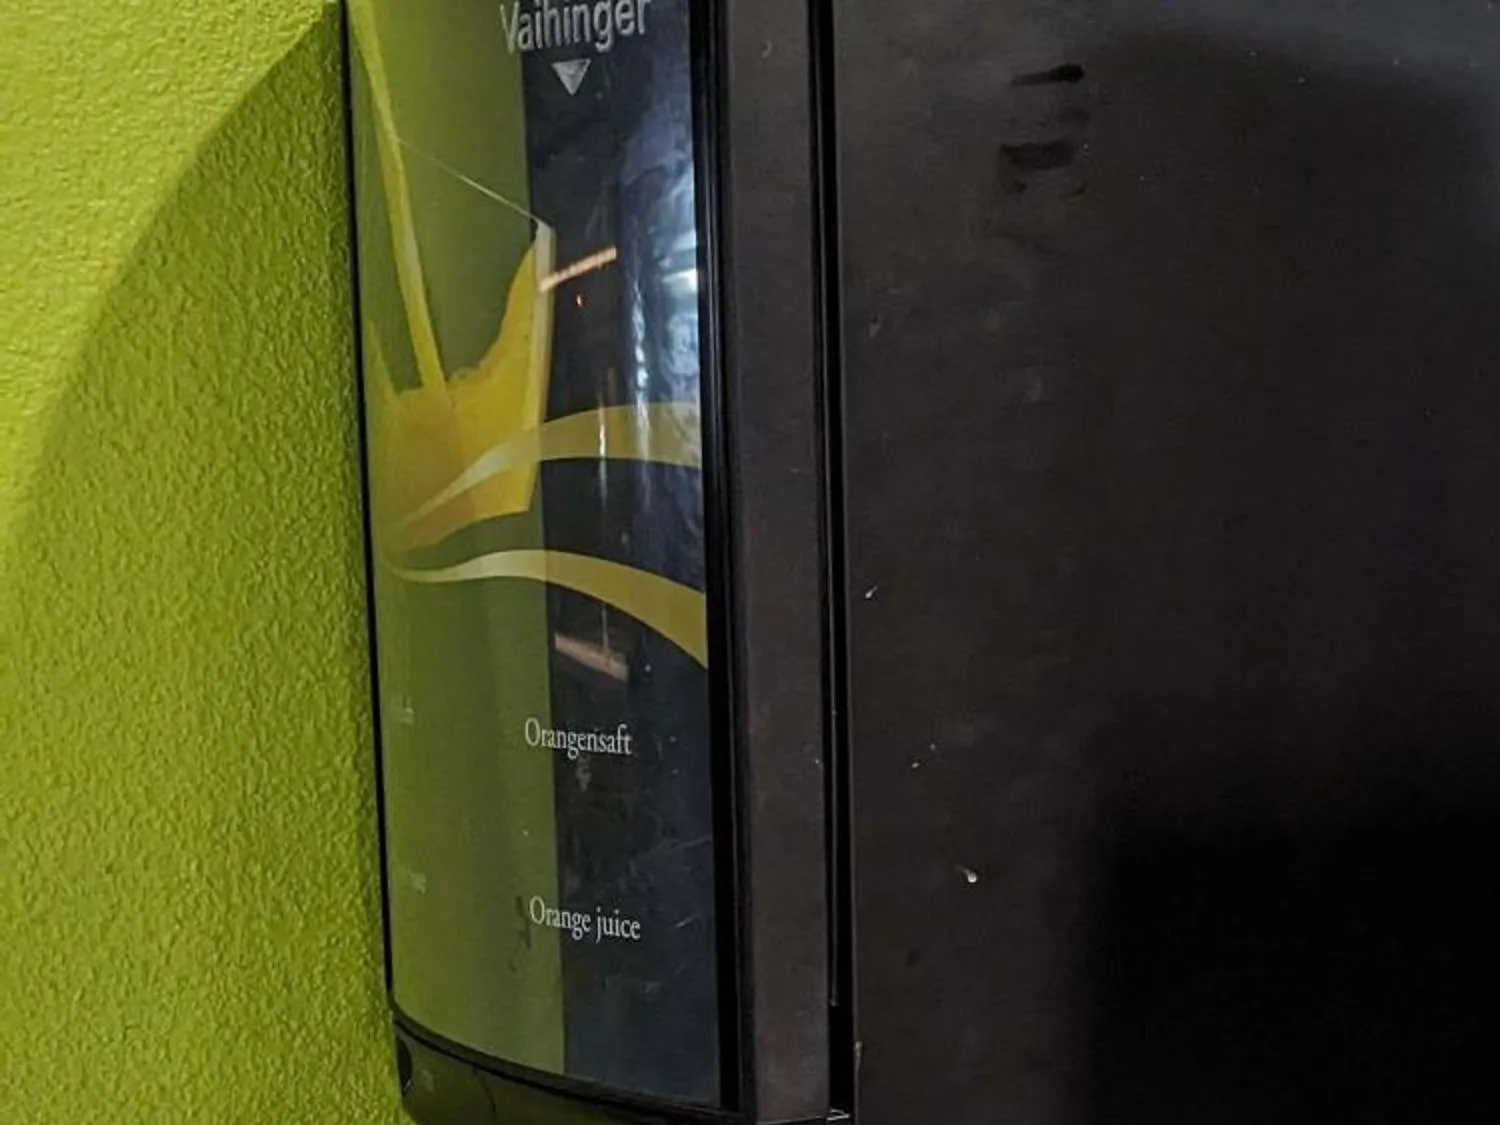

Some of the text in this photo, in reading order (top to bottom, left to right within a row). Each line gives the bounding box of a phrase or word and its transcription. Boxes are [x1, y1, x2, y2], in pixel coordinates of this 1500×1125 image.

[500, 0, 652, 52] Vaihinger
[524, 716, 633, 760] Orangensaft
[529, 895, 642, 944] Orange juice
